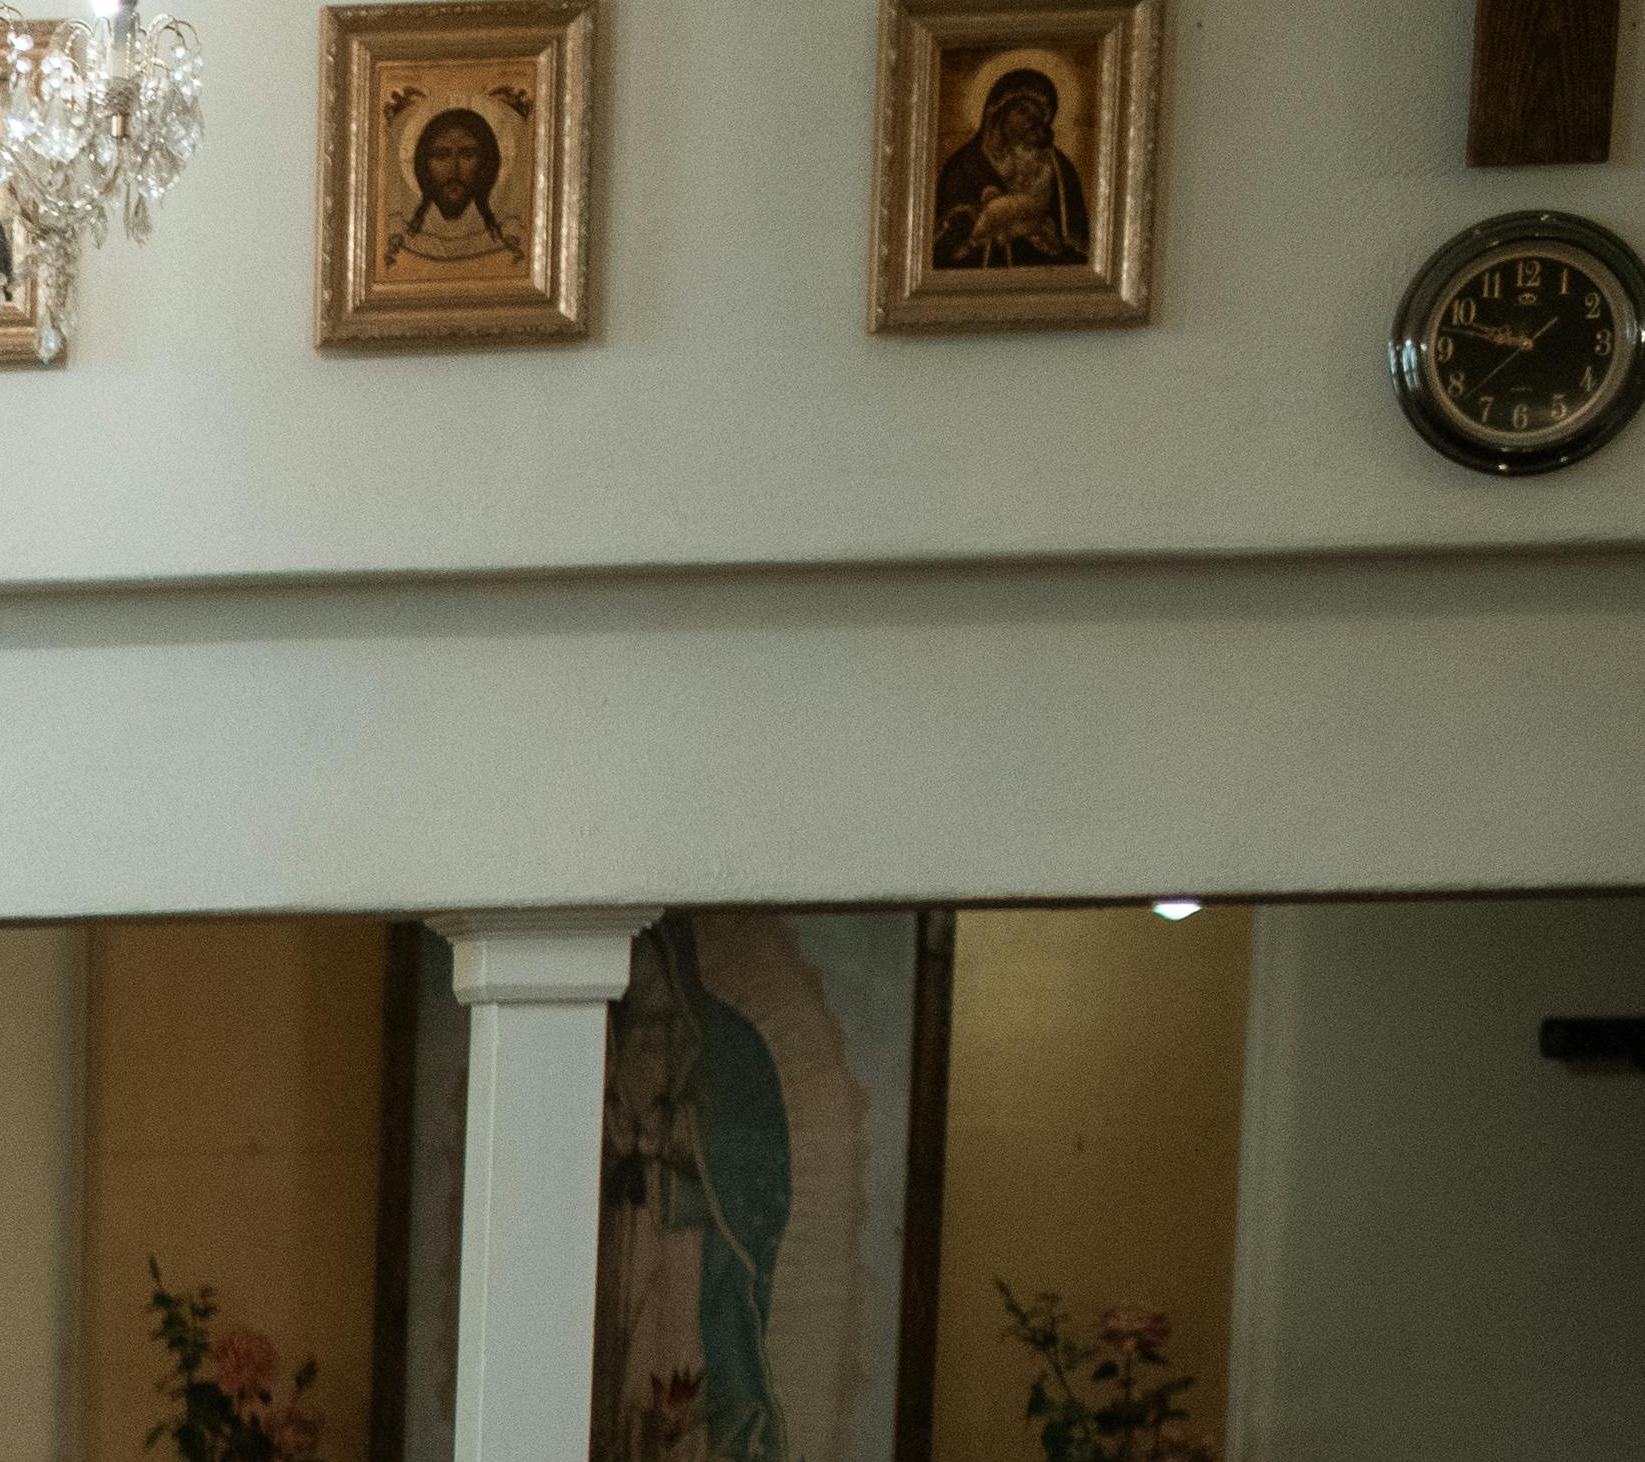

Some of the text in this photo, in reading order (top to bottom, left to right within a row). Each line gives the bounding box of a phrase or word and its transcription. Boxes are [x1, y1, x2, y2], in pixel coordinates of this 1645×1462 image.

[1482, 271, 1501, 299] 11
[1516, 259, 1542, 288] 12
[1560, 268, 1570, 296] 1
[1452, 299, 1476, 326] 10
[1584, 292, 1601, 319] 2
[1437, 336, 1454, 364] 9
[1595, 329, 1612, 356] 3
[1447, 370, 1465, 397] 8
[1579, 365, 1594, 392] 4
[1480, 396, 1494, 423] 7
[1512, 403, 1529, 430] 6
[1551, 394, 1567, 420] 5
